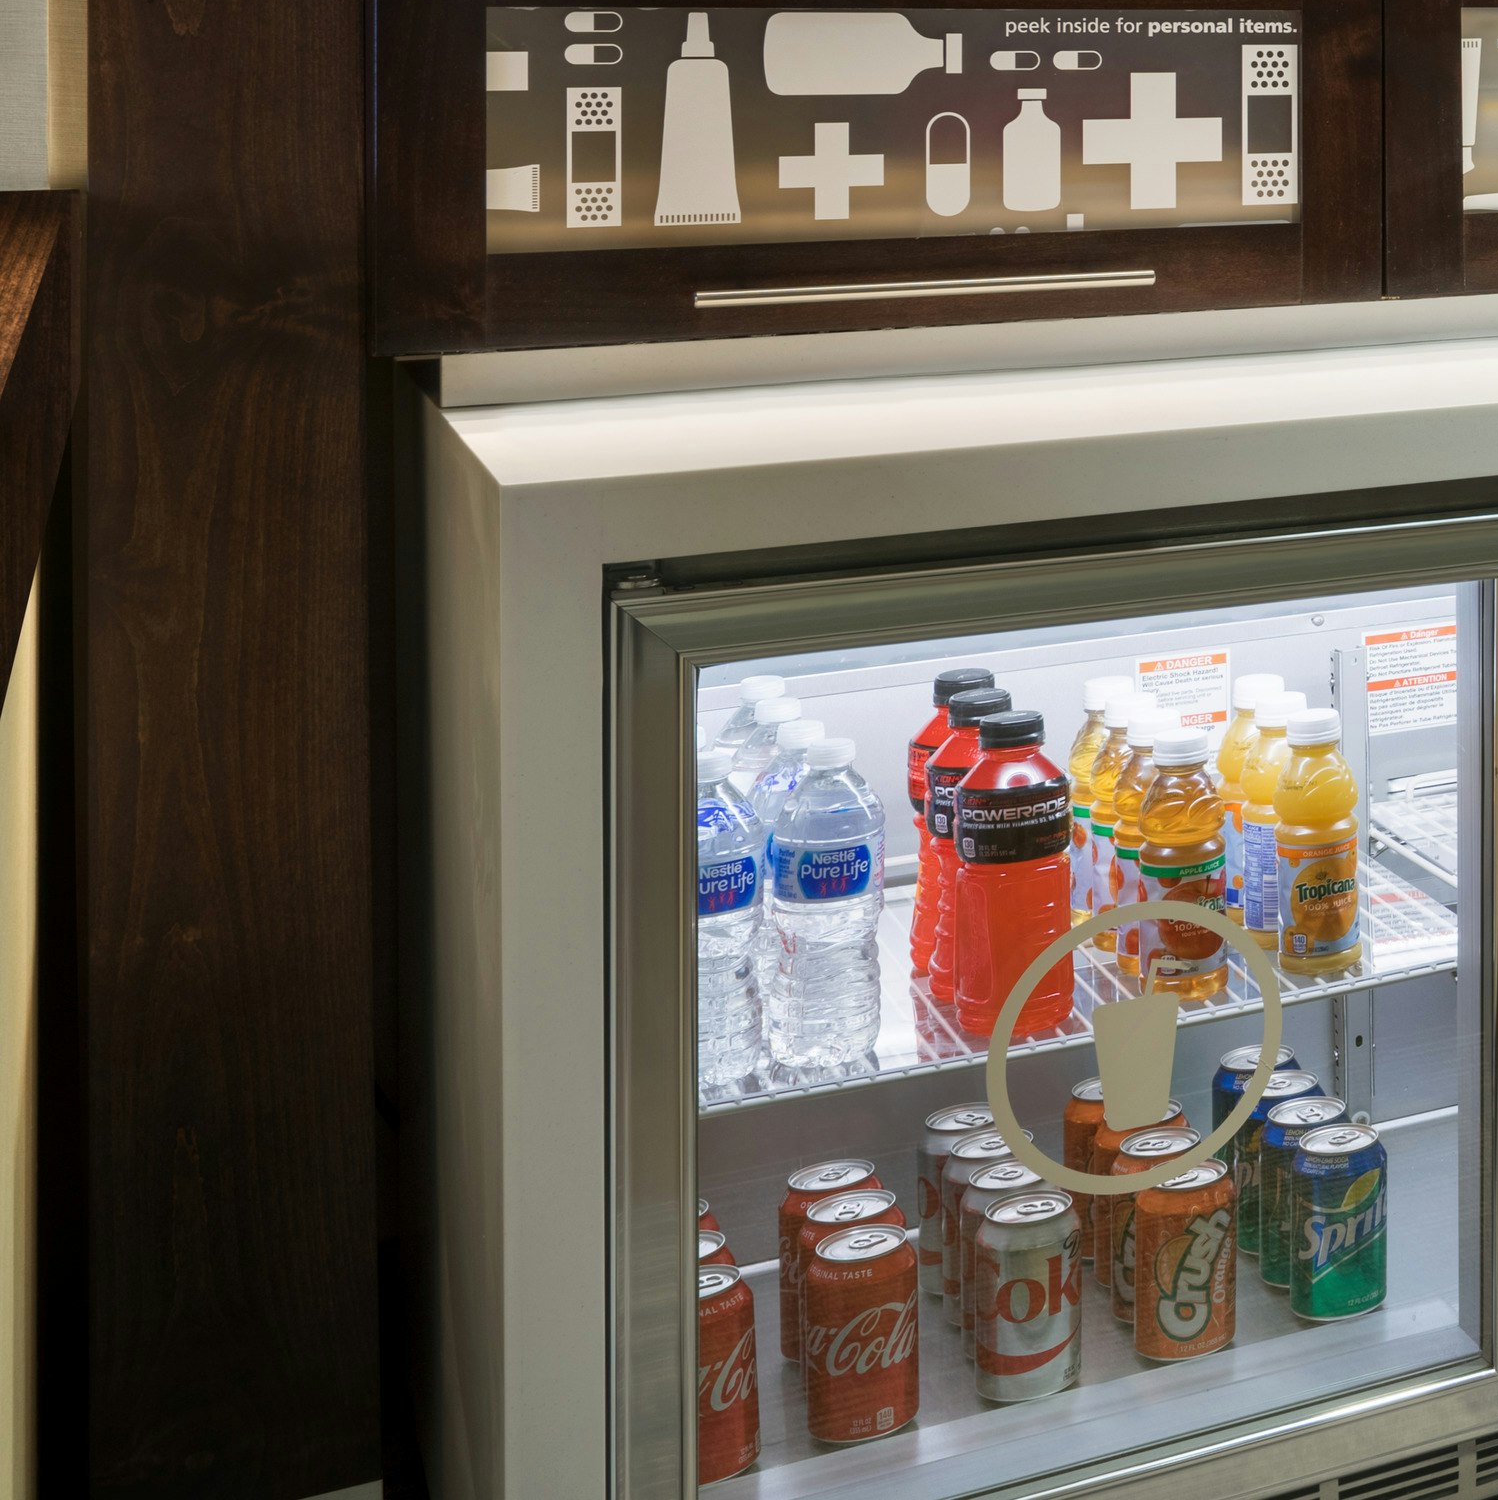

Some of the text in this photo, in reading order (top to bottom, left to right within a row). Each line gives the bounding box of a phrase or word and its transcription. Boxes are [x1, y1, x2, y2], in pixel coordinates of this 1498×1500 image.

[1005, 17, 1298, 38] peek inside for personal items.
[1410, 629, 1439, 640] Danger
[1166, 656, 1214, 671] DANGER
[1170, 671, 1189, 680] Shock
[1402, 673, 1448, 687] ATTENTION
[962, 796, 1067, 821] POWERADE
[963, 839, 974, 850] 130
[812, 847, 855, 864] Nestlé
[1302, 848, 1332, 859] ORANGE
[801, 859, 868, 882] Pure Life
[1179, 866, 1203, 877] APPLE
[731, 871, 754, 893] Life
[1296, 877, 1355, 903] Tropicana
[1303, 895, 1352, 912] 100% JUICE
[842, 1268, 873, 1280] TASTE
[1157, 1208, 1232, 1342] Crush
[1211, 1235, 1234, 1306] Orange
[719, 1292, 744, 1311] TASTE
